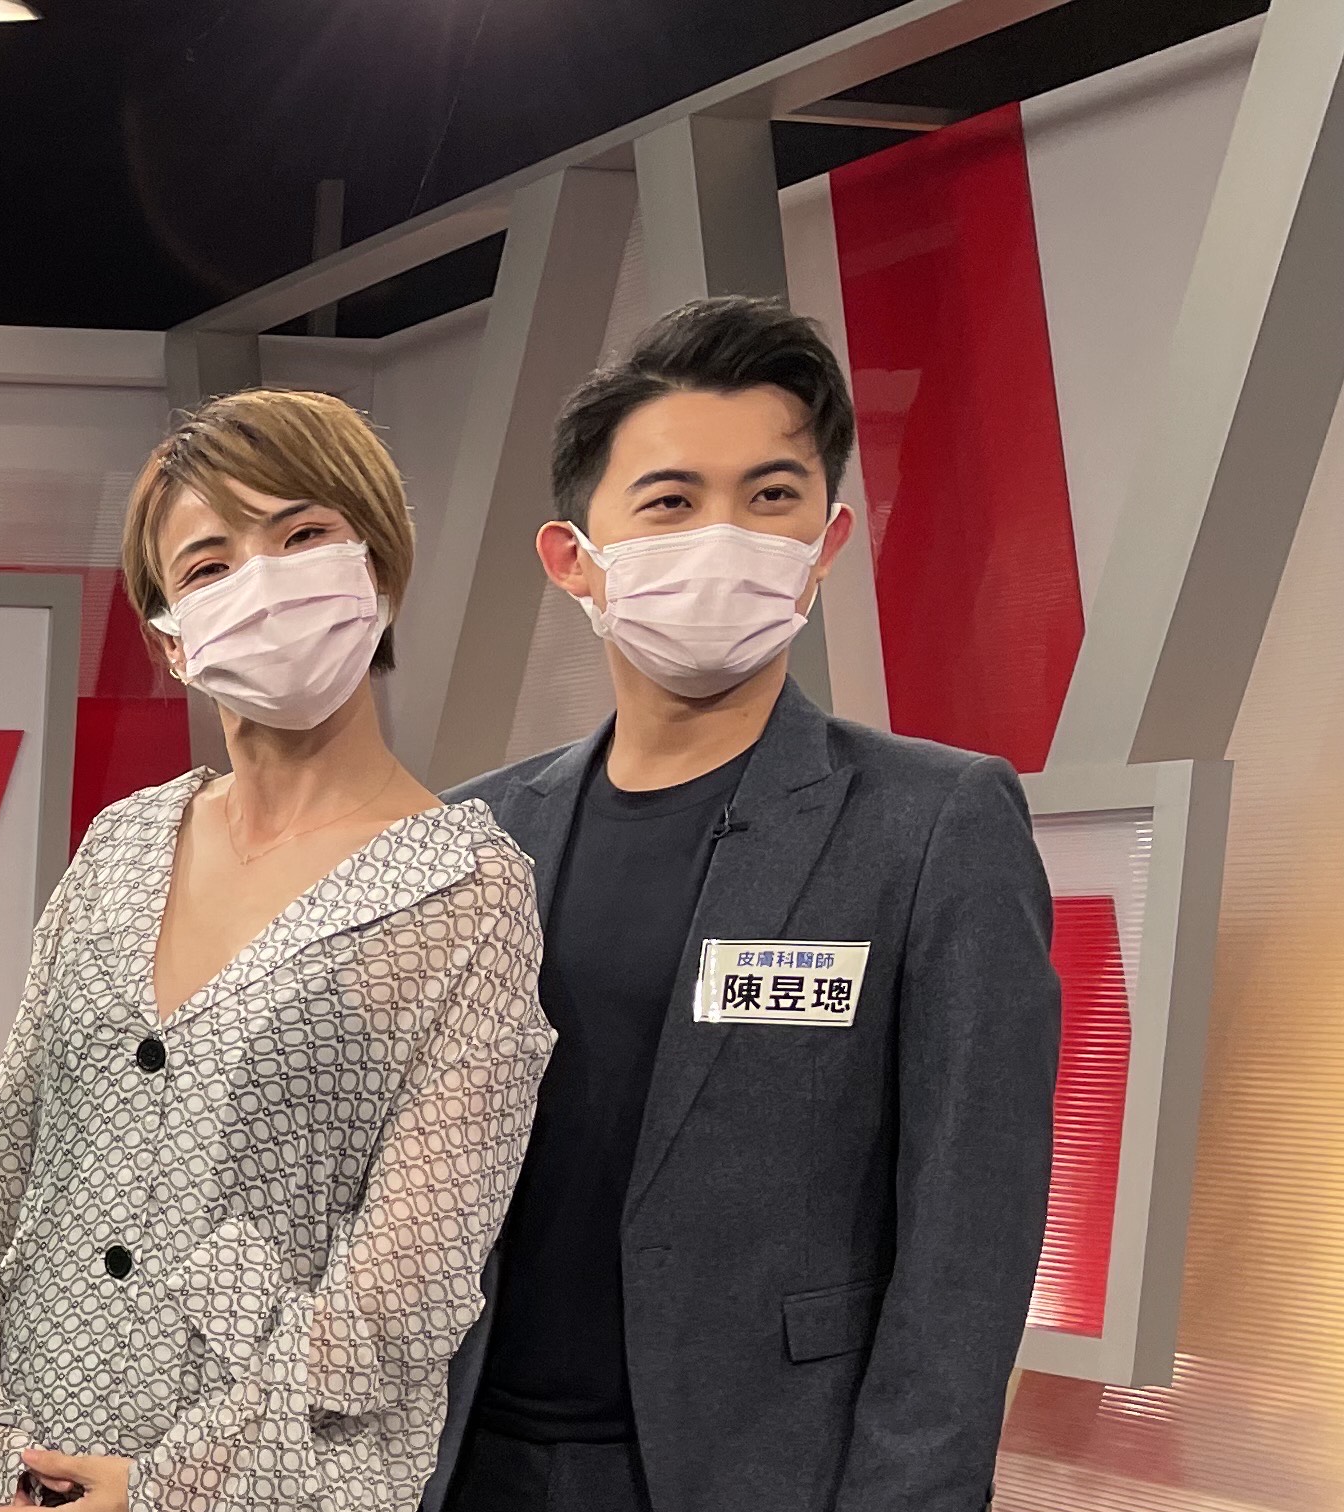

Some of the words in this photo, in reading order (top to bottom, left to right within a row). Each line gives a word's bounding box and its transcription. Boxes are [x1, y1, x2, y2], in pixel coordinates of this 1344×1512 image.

[737, 951, 836, 969] 皮膚科醫師
[721, 973, 853, 1013] 陳昱璁
